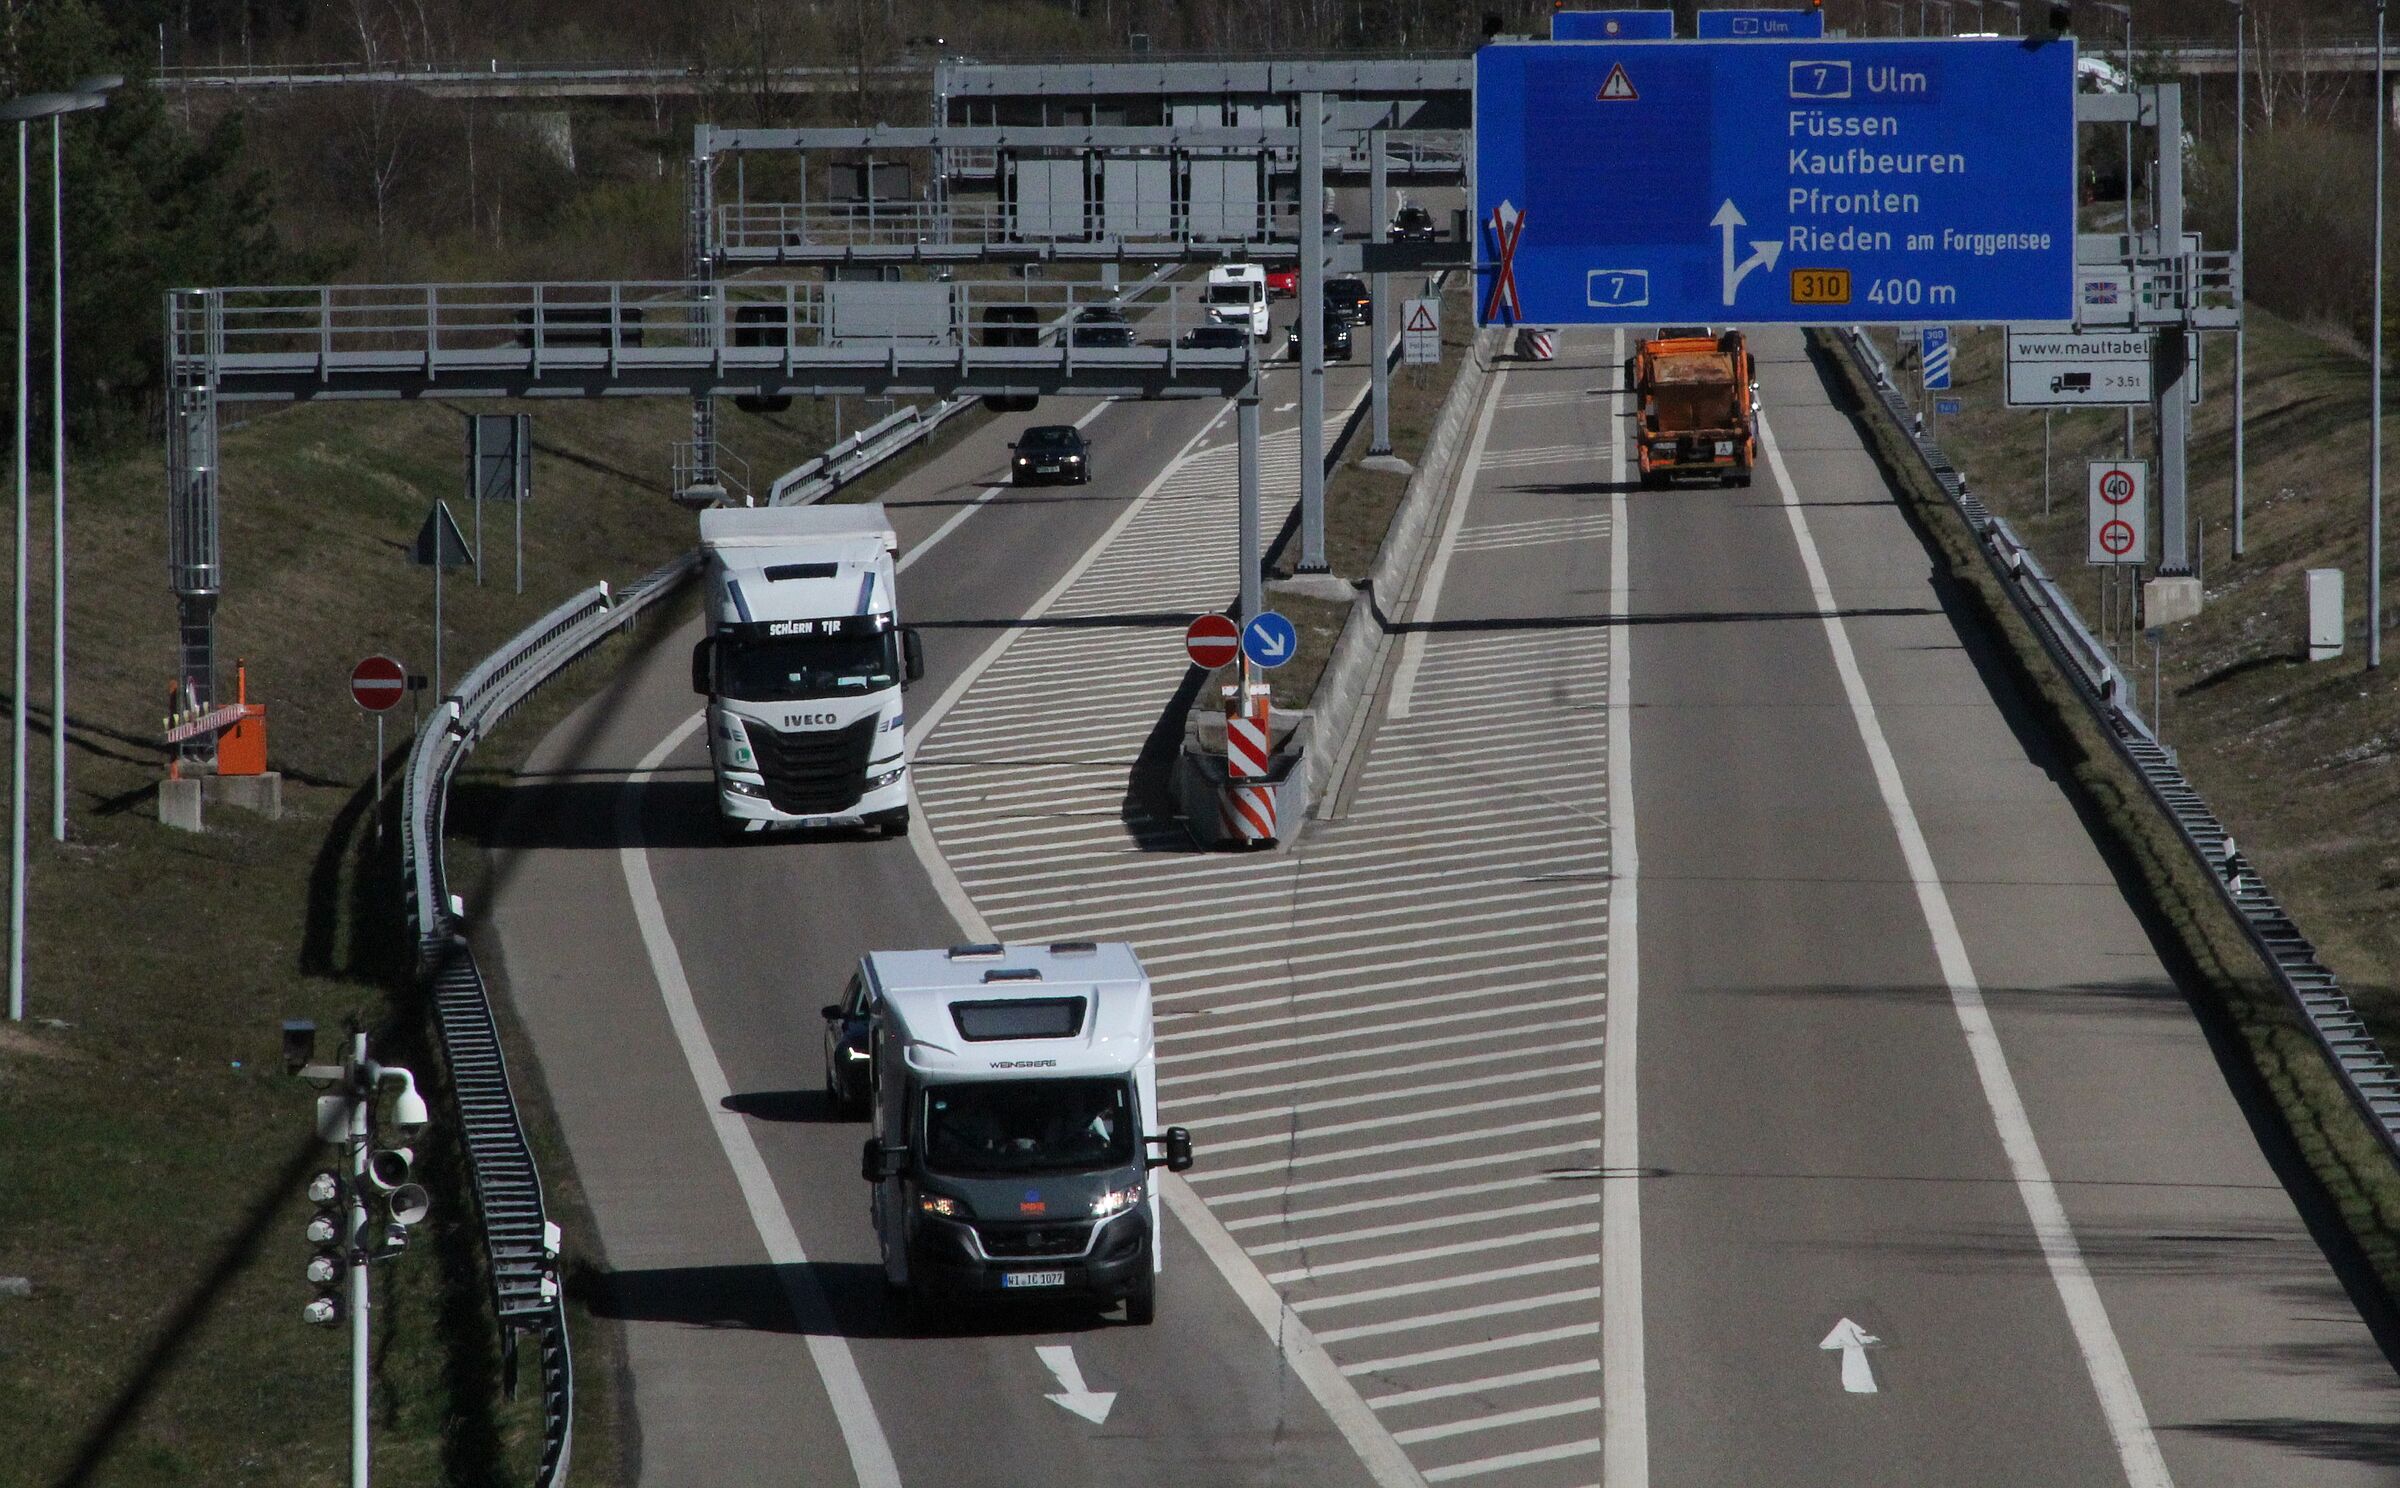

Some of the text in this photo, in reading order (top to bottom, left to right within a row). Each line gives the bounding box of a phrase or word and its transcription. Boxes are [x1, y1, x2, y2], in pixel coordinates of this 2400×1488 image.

[1741, 21, 1788, 33] 7 Ulm
[1814, 68, 1927, 93] 7 Ulm
[1790, 112, 1898, 137] Füssen
[1790, 150, 1966, 175] Kaufbeuren
[1790, 190, 1920, 214] Pfronten
[1790, 229, 2051, 256] Rieden am Forggensee
[1611, 279, 1624, 299] 7
[1801, 278, 1841, 298] 310
[1868, 279, 1956, 304] 400 m
[2019, 340, 2149, 355] www.mauttabel
[1720, 443, 1728, 453] A
[2107, 480, 2127, 495] 40
[769, 620, 841, 636] SCHLERN TIR
[784, 713, 837, 727] IVECO
[989, 1060, 1056, 1068] WEINSBERG
[1041, 1273, 1062, 1284] 1077
